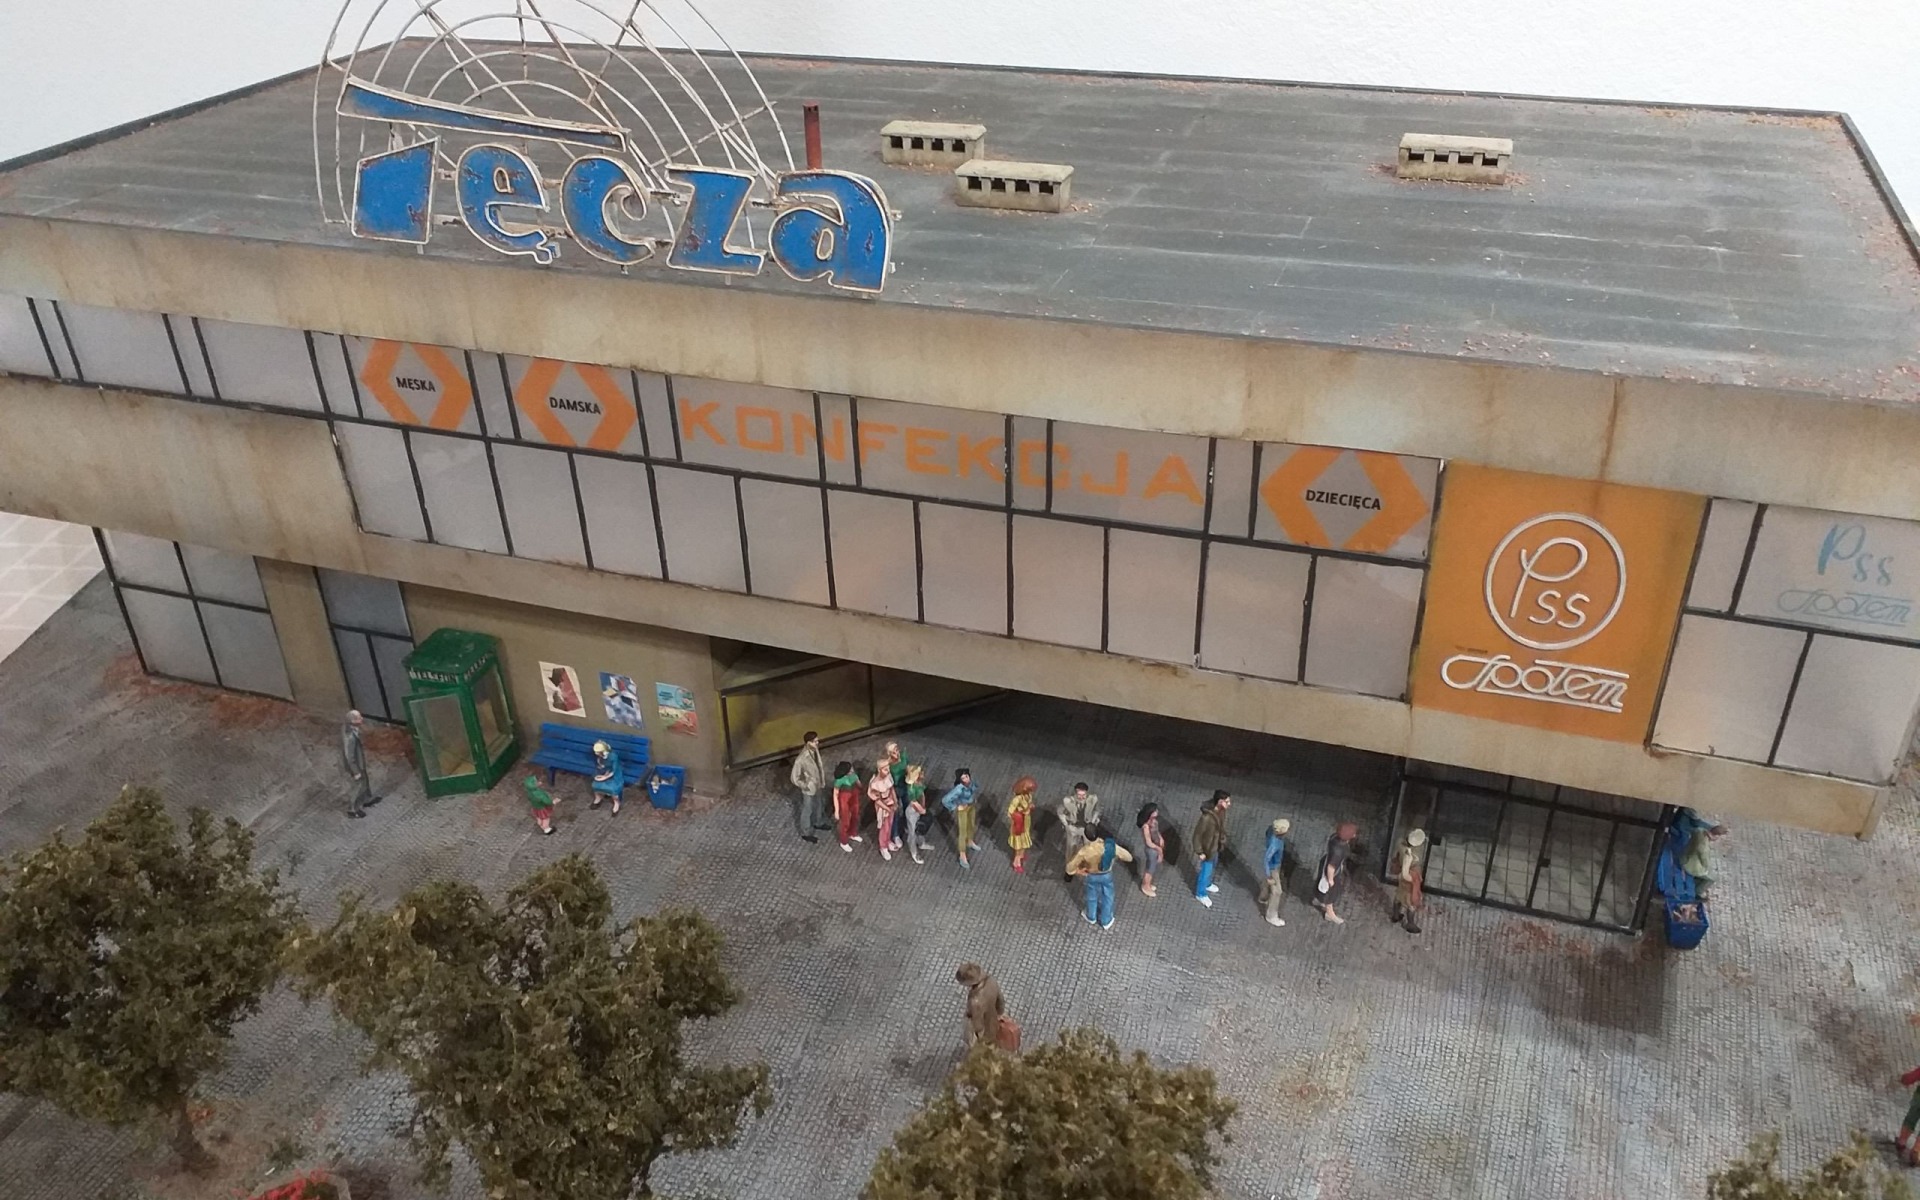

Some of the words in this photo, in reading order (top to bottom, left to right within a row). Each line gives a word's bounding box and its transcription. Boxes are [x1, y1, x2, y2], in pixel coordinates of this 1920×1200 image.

[396, 376, 436, 393] MĘSKA
[549, 396, 602, 415] DAMSKA
[679, 398, 1205, 506] KONFEKCJA
[1305, 489, 1381, 511] DZIECIĘCA
